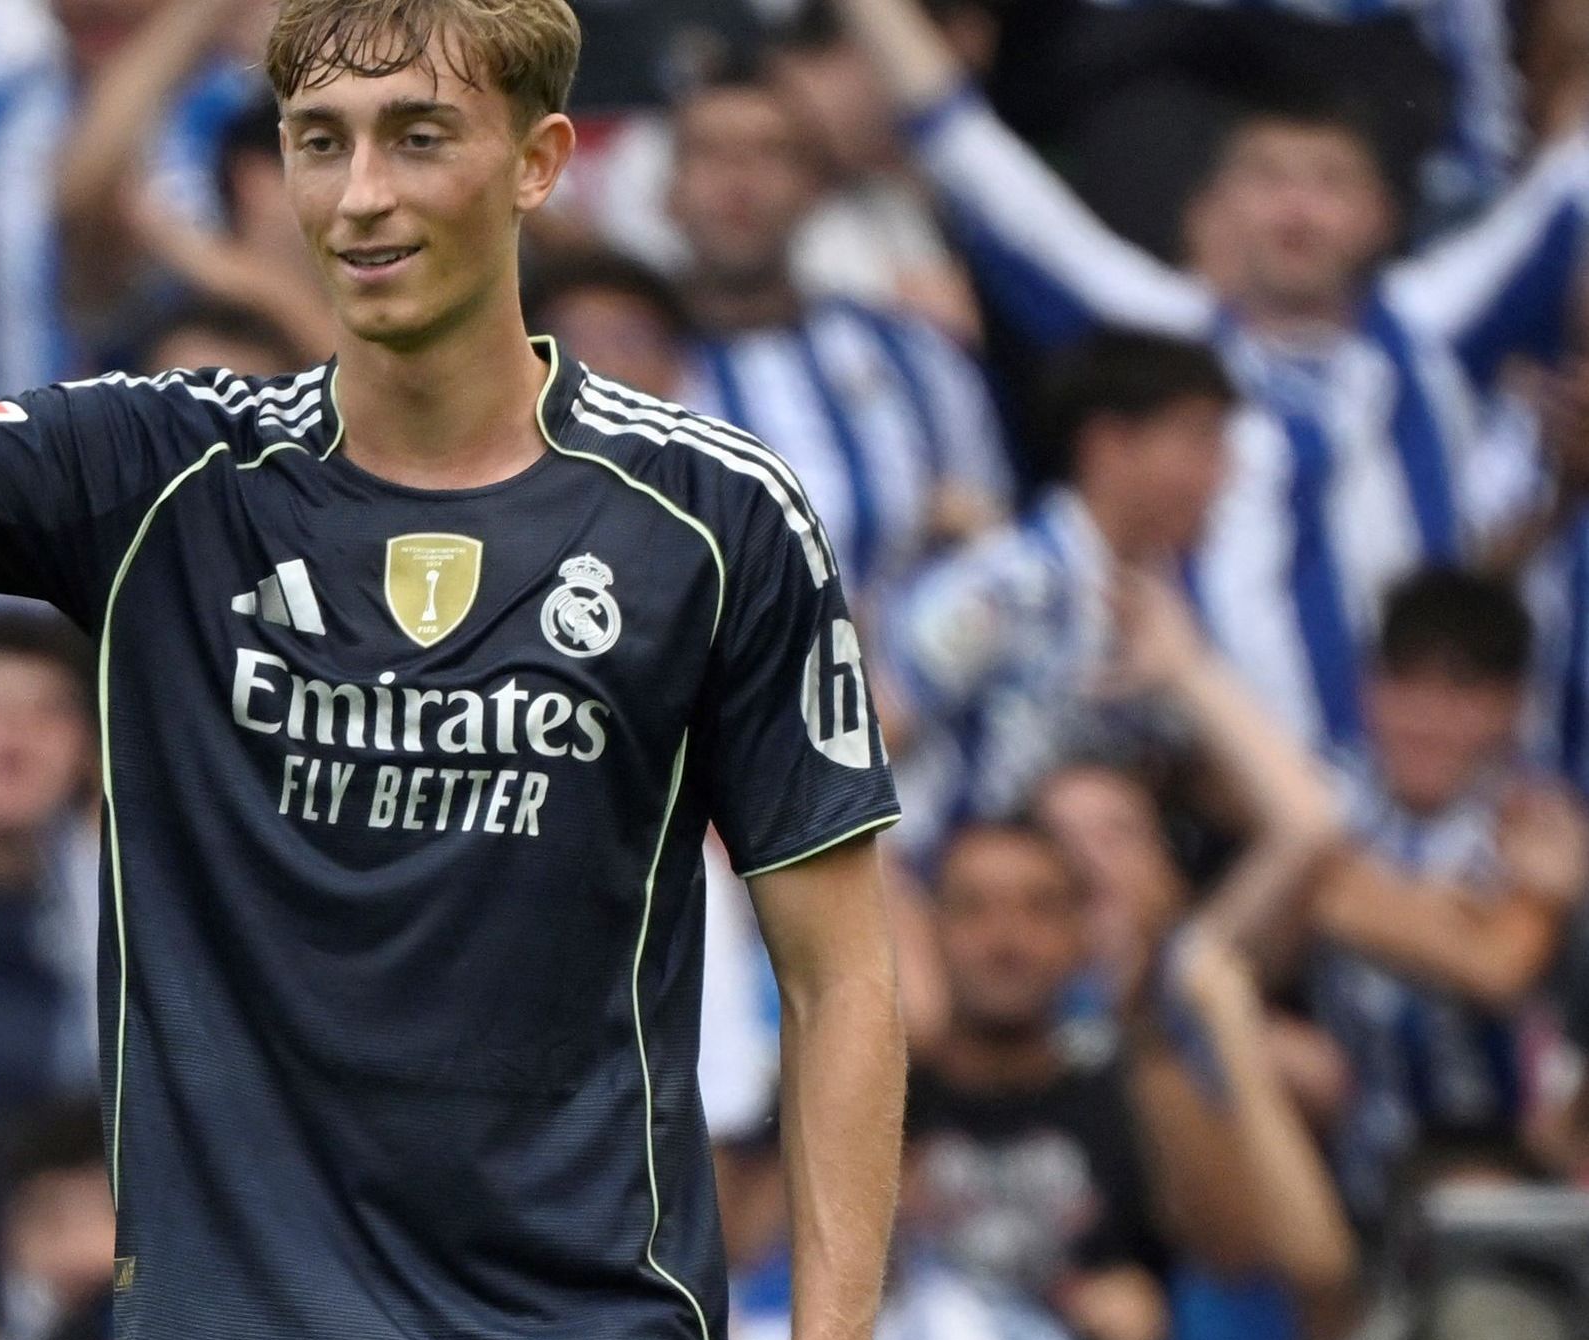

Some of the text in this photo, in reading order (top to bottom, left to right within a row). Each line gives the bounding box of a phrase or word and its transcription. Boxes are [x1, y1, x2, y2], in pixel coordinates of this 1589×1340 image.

[231, 647, 612, 763] Emirates
[278, 754, 551, 837] FLY BETTER
